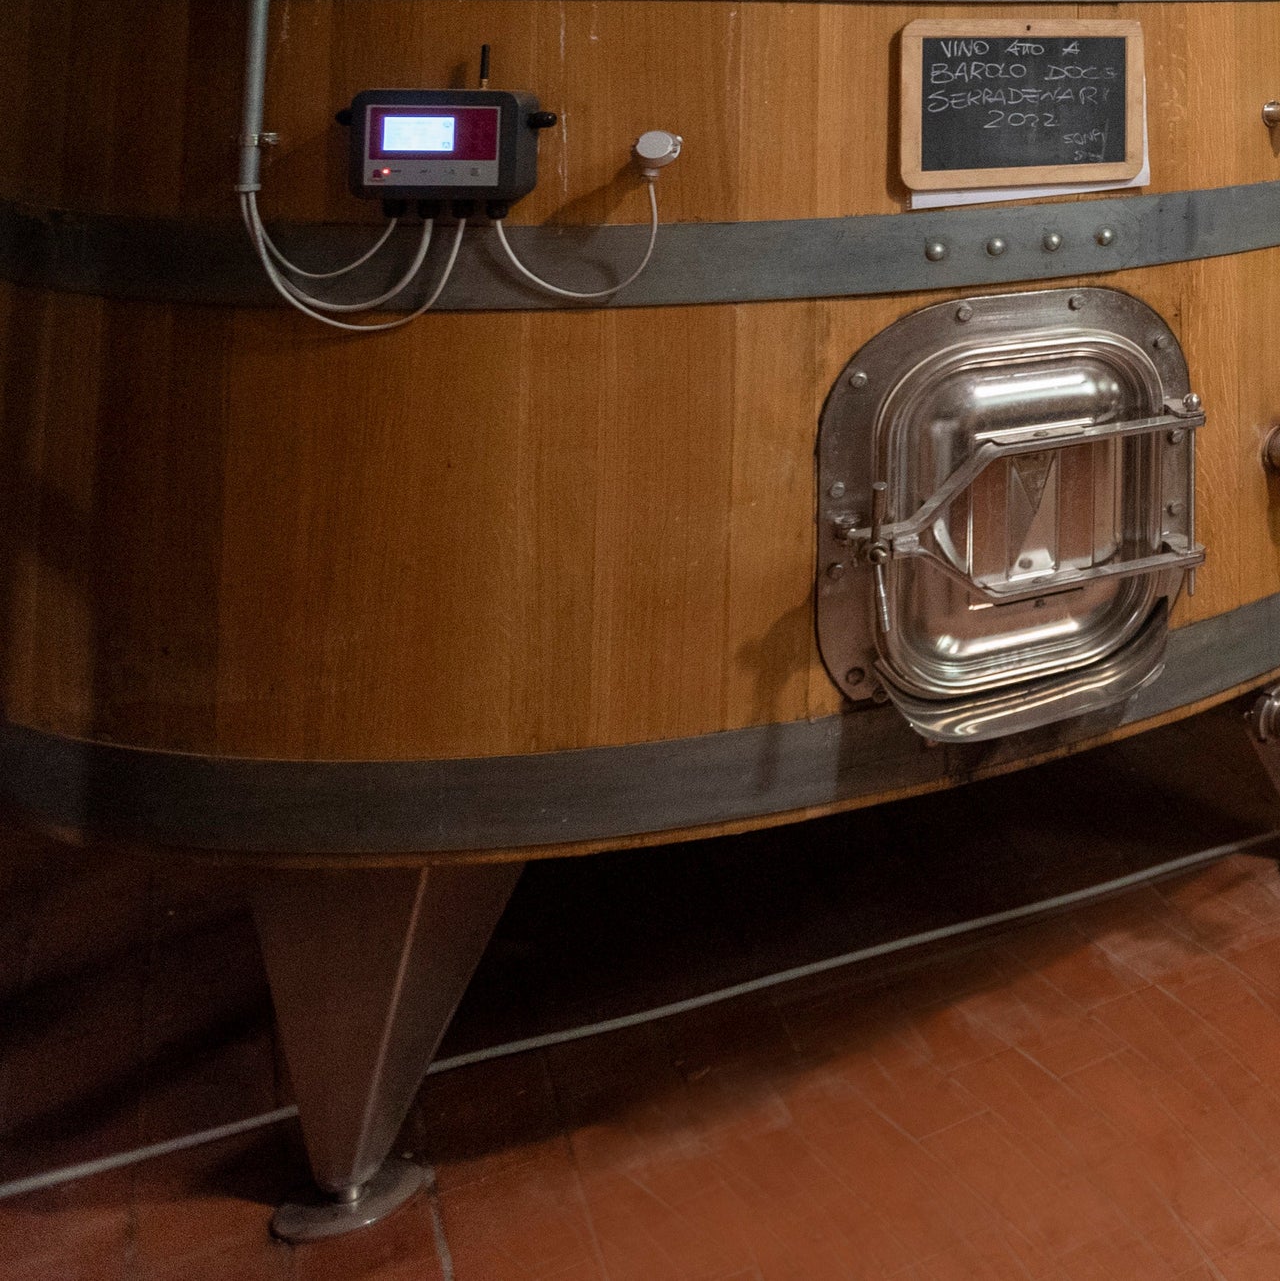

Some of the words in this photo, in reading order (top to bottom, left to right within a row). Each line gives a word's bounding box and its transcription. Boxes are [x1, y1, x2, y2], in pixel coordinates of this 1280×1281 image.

[940, 40, 989, 58] VINO
[1062, 41, 1080, 56] A
[930, 62, 1027, 84] BAROLO
